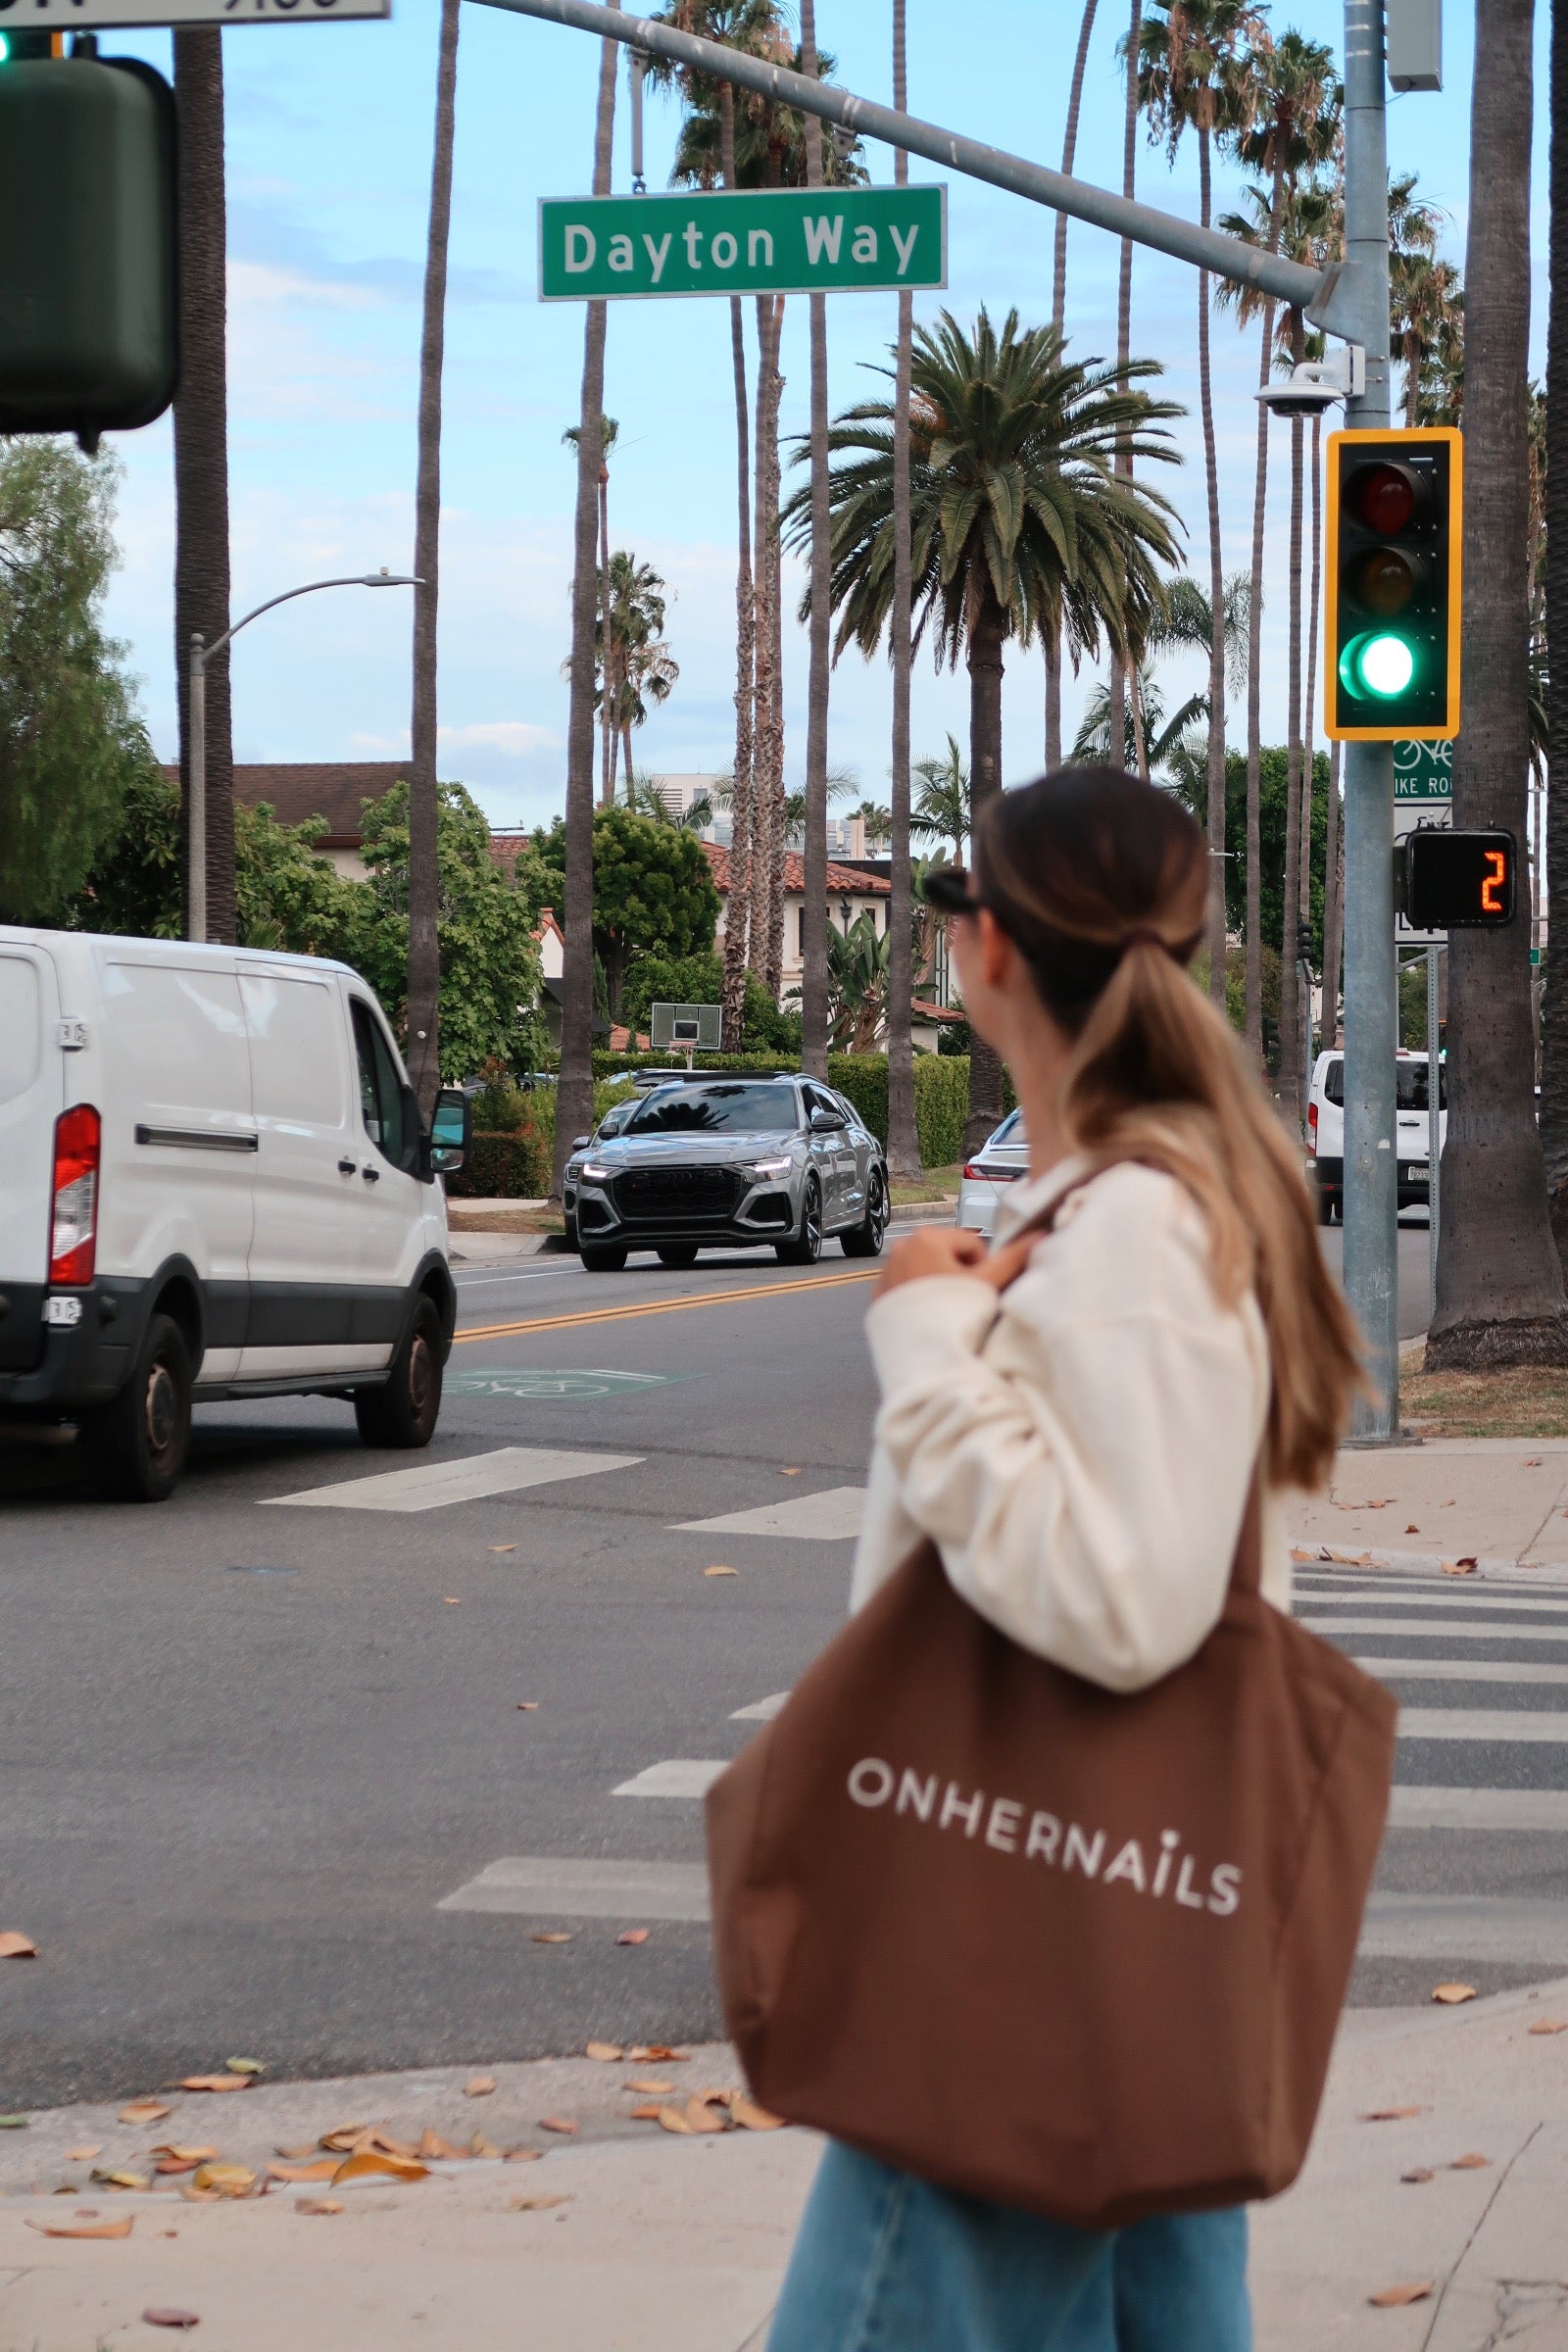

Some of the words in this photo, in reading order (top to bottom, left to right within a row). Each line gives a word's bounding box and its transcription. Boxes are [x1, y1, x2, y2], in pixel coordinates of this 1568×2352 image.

[564, 220, 774, 283] Dayton
[803, 214, 920, 275] Way
[1395, 777, 1418, 794] IKE
[1428, 776, 1452, 794] RO
[1482, 852, 1505, 911] 2
